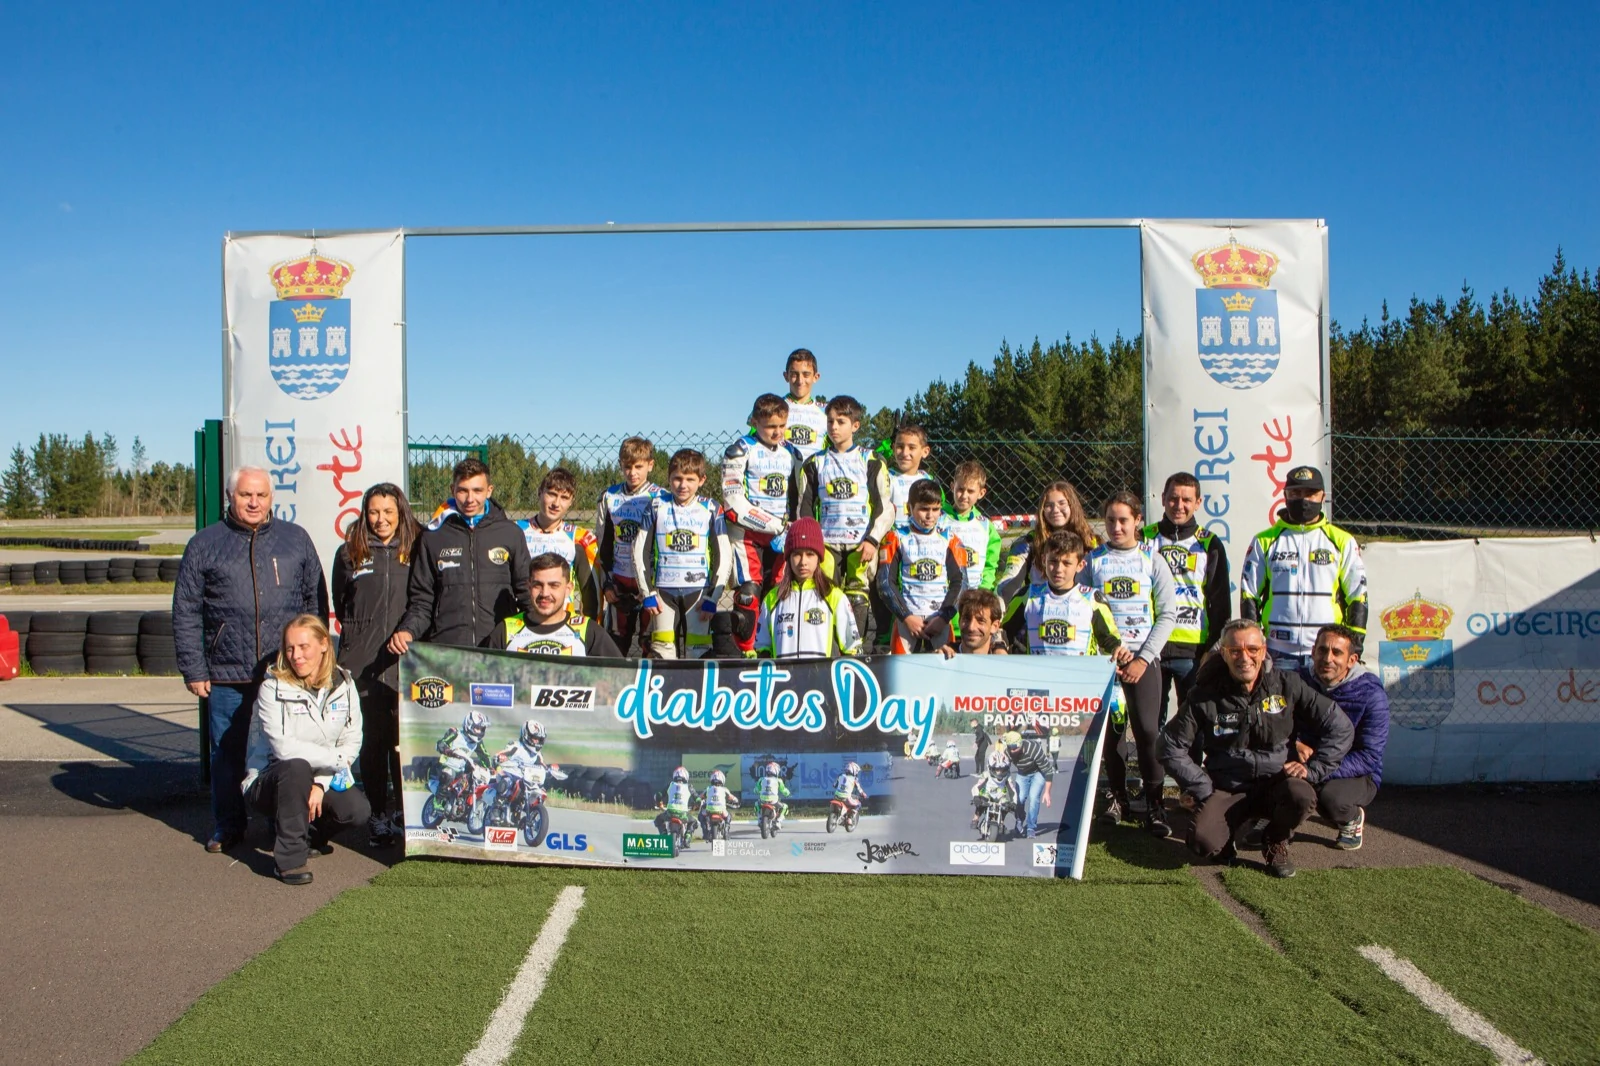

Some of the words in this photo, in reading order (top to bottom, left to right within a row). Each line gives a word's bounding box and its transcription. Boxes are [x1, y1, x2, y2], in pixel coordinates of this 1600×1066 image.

[1193, 408, 1236, 485] REI
[672, 532, 693, 547] KSB
[1111, 580, 1133, 594] KSB
[1045, 623, 1068, 639] KSB
[419, 683, 446, 701] KSB
[1557, 667, 1600, 703] de
[534, 688, 593, 708] BS21
[954, 695, 1103, 713] MOTOCICLISMO
[615, 658, 827, 738] diabetes
[831, 658, 937, 759] Day
[984, 713, 1024, 727] PARA
[1031, 713, 1081, 727] TODOS
[626, 837, 669, 849] MASTIL
[727, 841, 755, 849] XUNTA
[953, 843, 1000, 854] anedia
[739, 849, 771, 857] GALICIA
